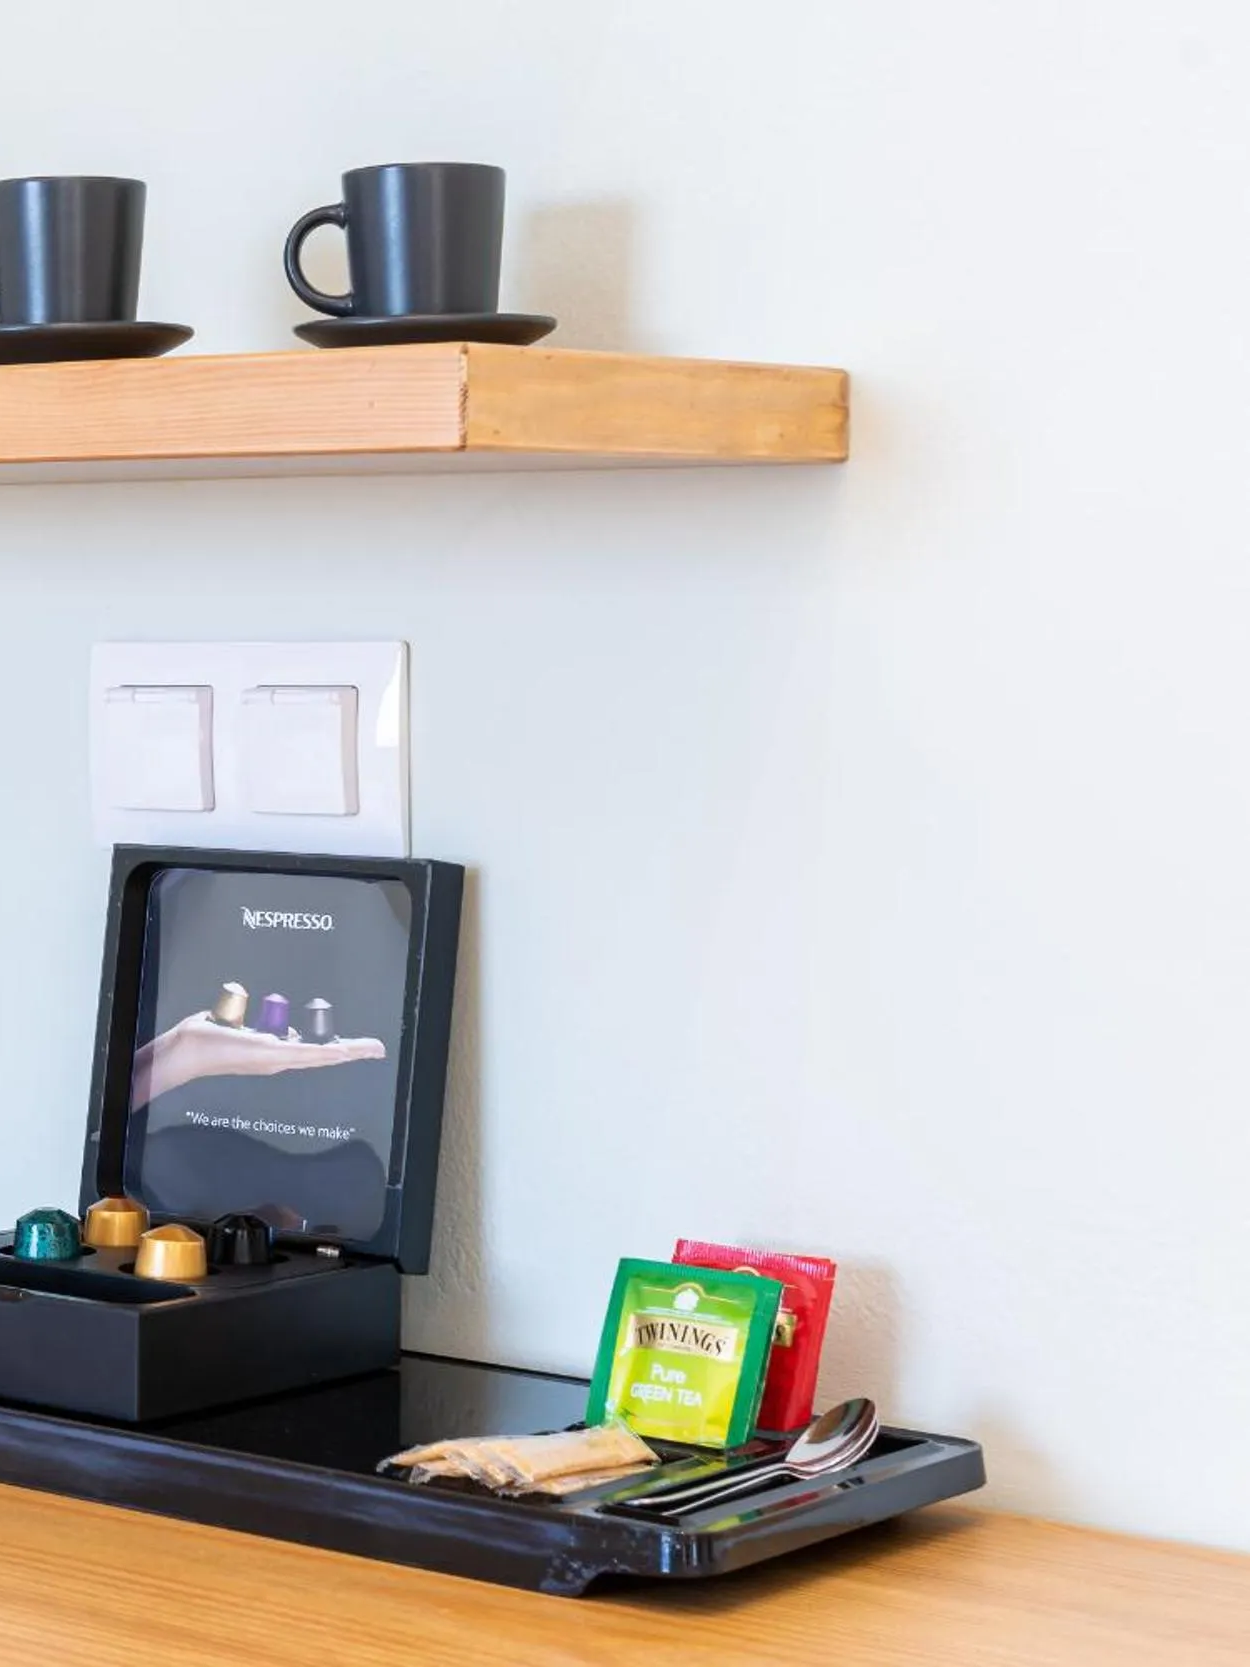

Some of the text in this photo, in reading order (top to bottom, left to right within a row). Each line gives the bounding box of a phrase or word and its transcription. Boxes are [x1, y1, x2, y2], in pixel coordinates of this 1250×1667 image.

[241, 906, 333, 931] NESPRESSO
[211, 1116, 229, 1128] are
[231, 1116, 251, 1129] the
[252, 1119, 296, 1134] choices
[298, 1126, 316, 1137] we
[636, 1322, 727, 1356] TWININGS
[651, 1364, 687, 1384] Pure
[630, 1383, 702, 1406] GREEN TEA
